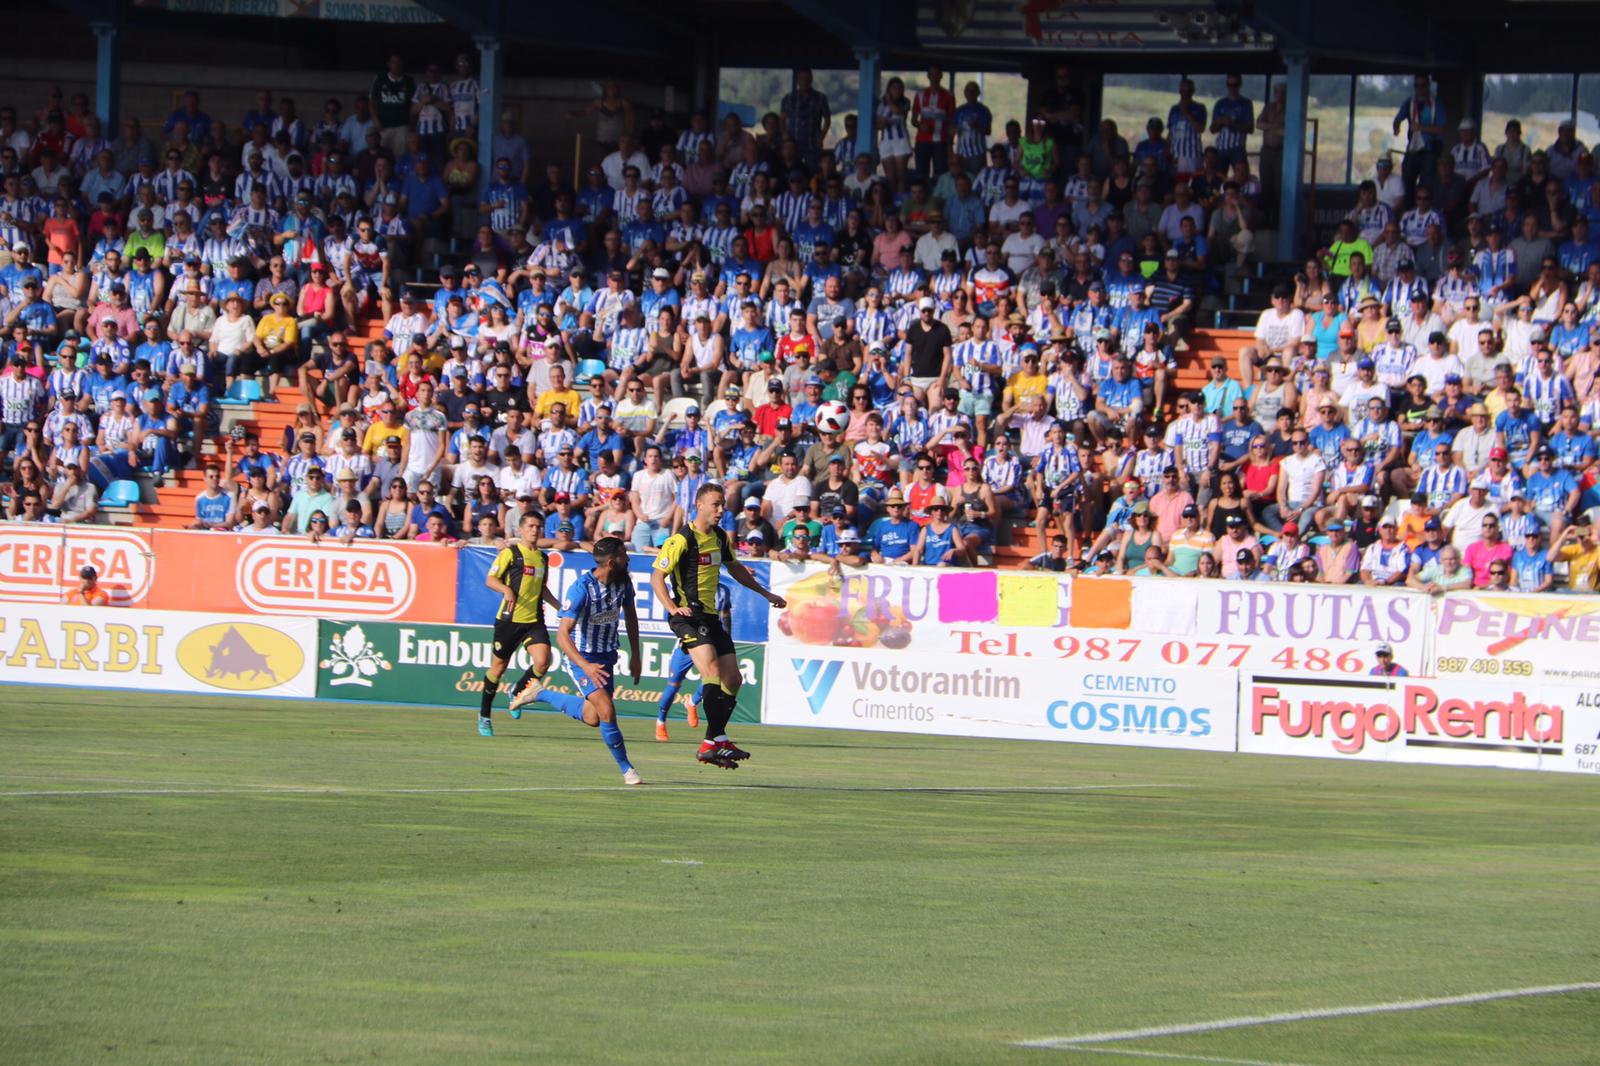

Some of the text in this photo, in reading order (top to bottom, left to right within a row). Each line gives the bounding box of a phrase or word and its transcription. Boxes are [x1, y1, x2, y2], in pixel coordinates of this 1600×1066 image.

[1216, 590, 1412, 643] FRUTAS
[0, 617, 164, 675] ARBI
[950, 629, 1365, 673] Tel. 987 077 486
[851, 661, 1020, 699] Votorantim
[1083, 674, 1176, 694] CEMENTO
[1438, 656, 1533, 676] 987 410 359
[852, 698, 935, 722] Cimentos
[1046, 700, 1212, 737] COSMOS
[1251, 685, 1564, 753] Furgo Renta
[1575, 743, 1598, 755] 687
